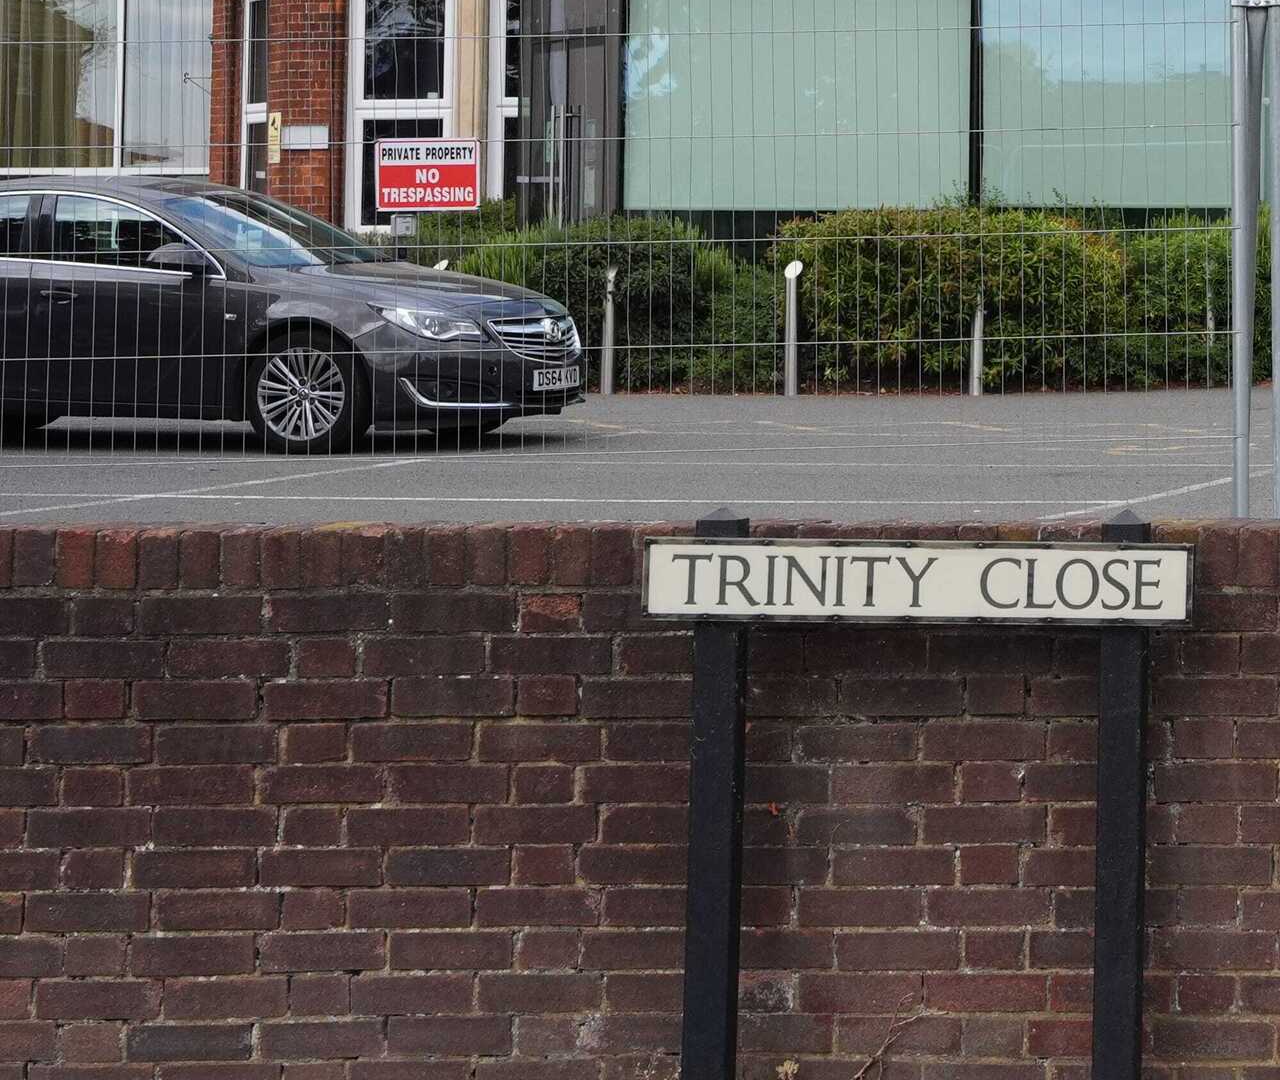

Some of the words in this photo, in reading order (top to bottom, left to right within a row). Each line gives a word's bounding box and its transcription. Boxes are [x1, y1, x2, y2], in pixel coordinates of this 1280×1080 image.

[381, 146, 420, 160] PRIVATE
[425, 146, 474, 160] PROPERTY
[415, 168, 440, 184] NO
[382, 186, 474, 203] TRESPASSING
[538, 370, 562, 386] DS64
[672, 552, 939, 608] TRINITY
[979, 557, 1164, 610] CLOSE
